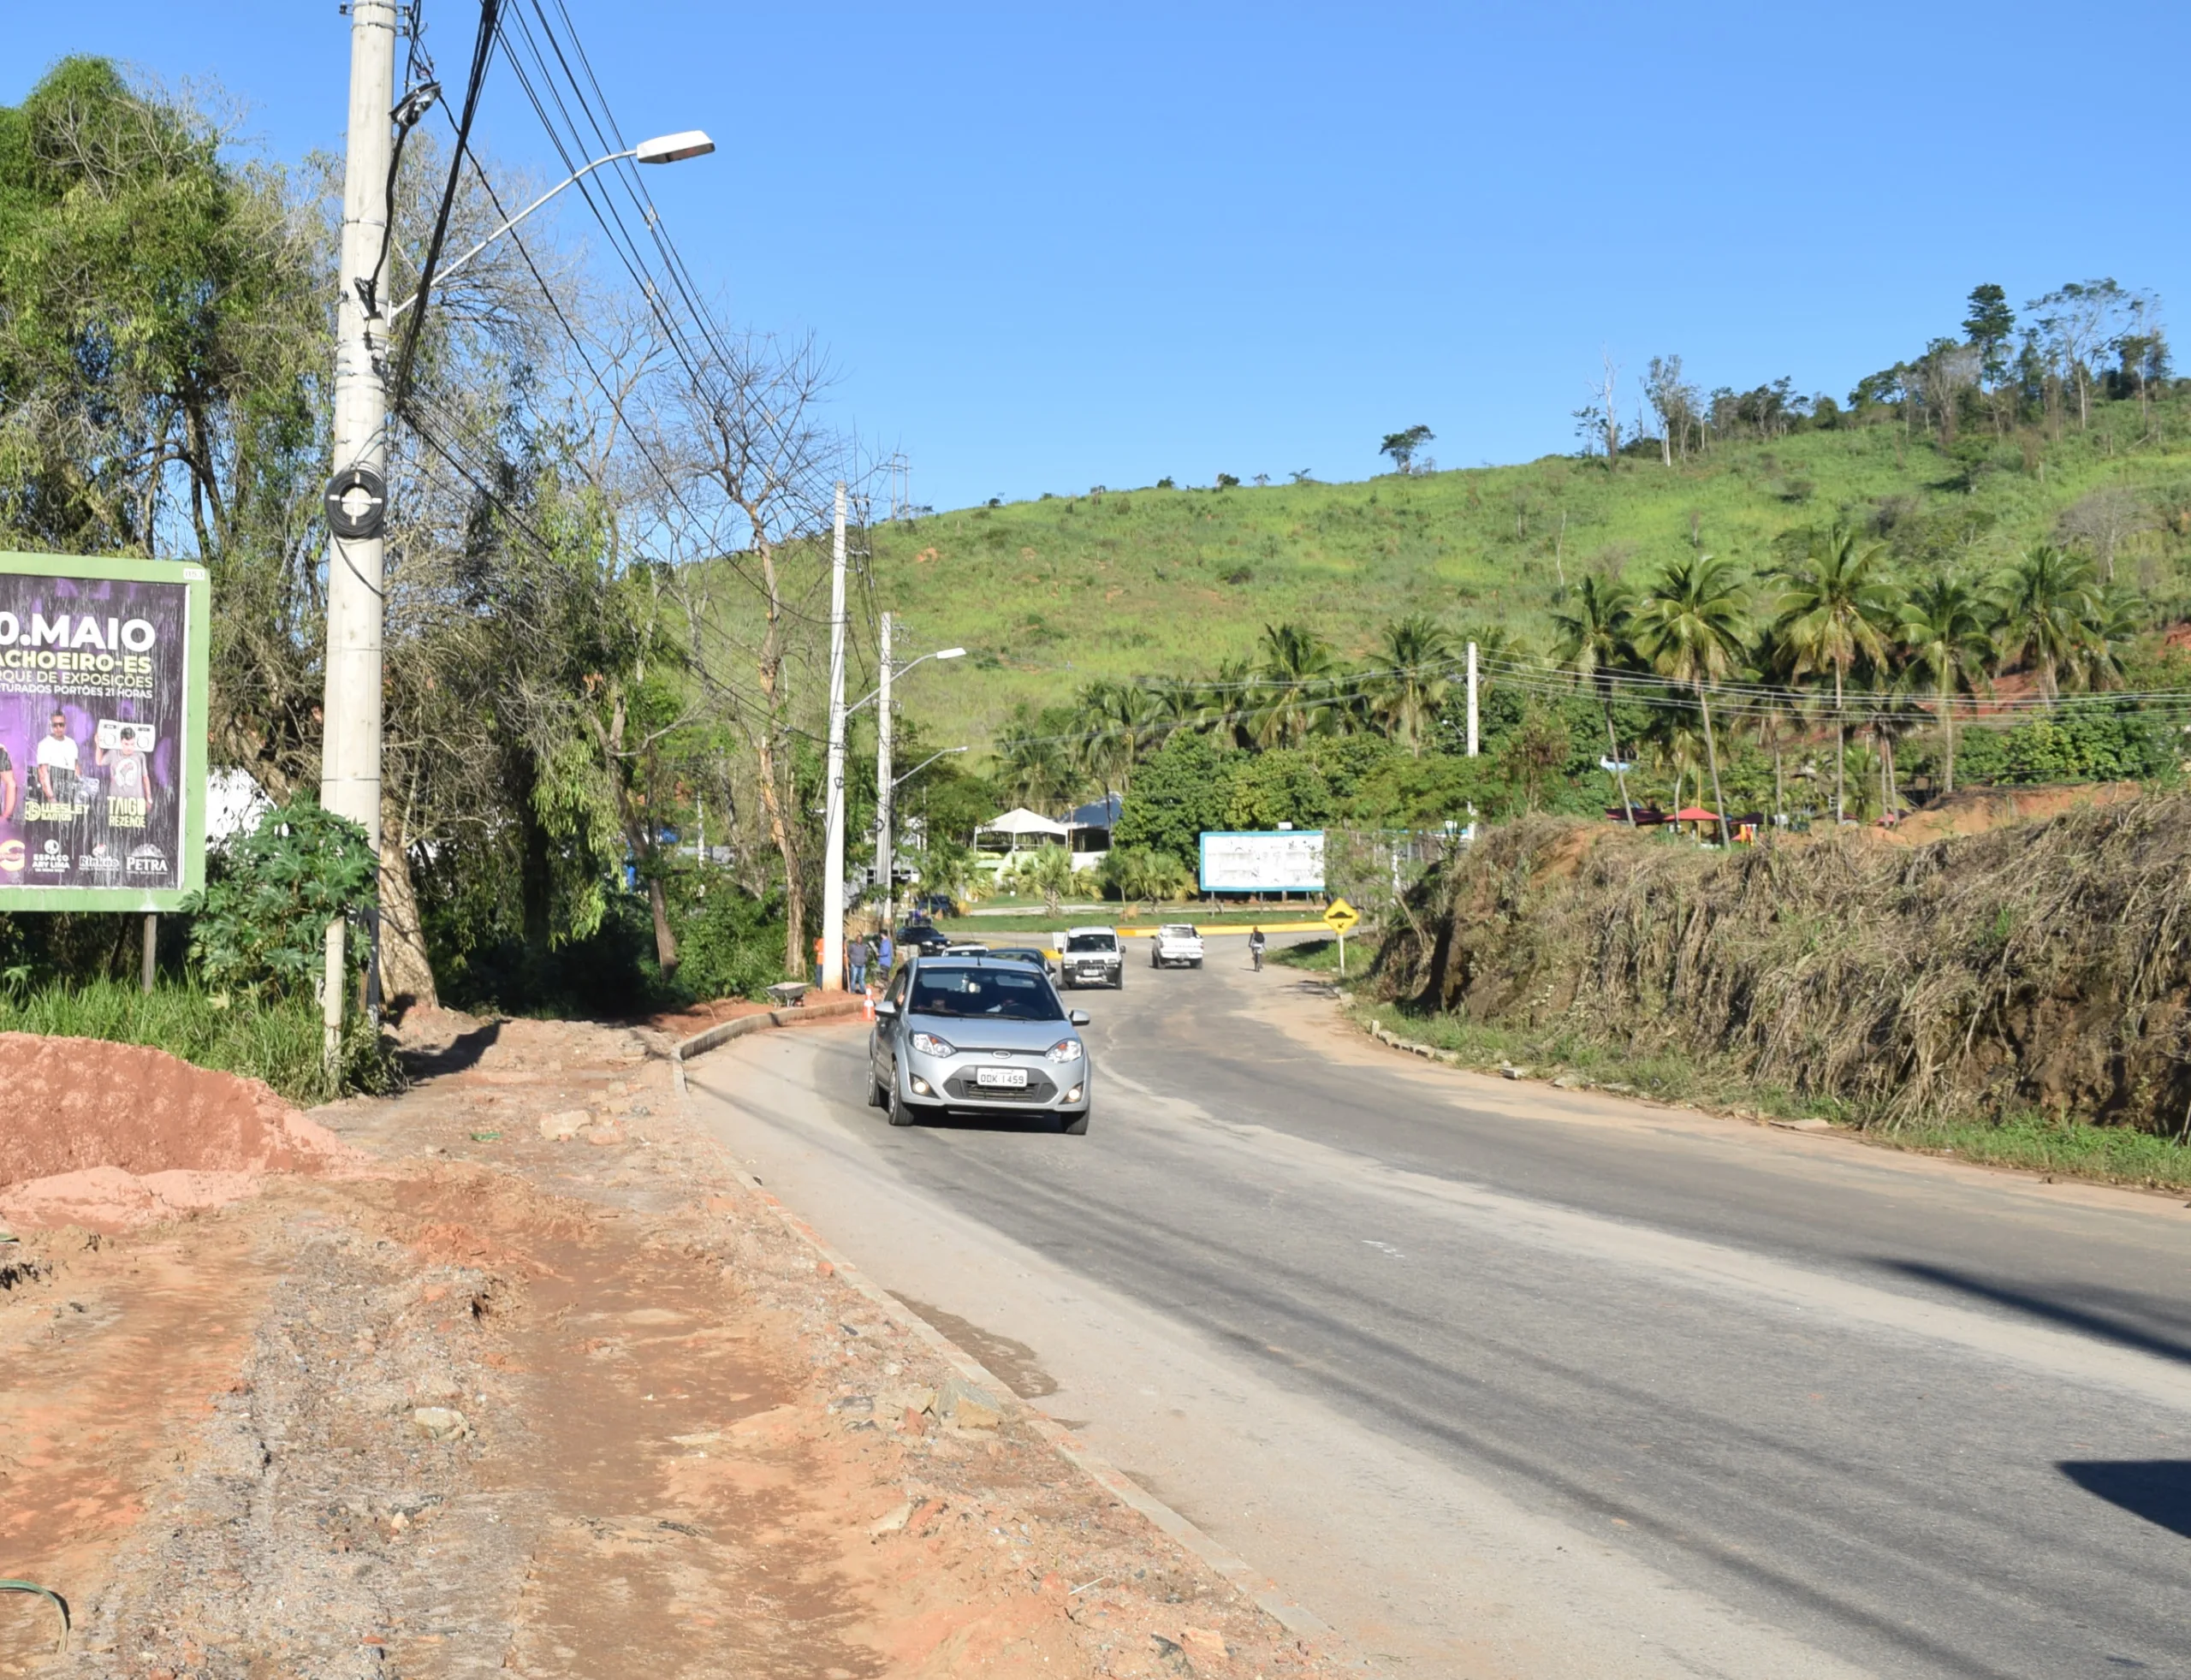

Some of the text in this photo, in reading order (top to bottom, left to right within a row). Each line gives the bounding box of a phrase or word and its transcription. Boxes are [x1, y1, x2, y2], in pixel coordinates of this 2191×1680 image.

[0, 669, 153, 689] QUE DE EXPOSIÇÕES
[0, 683, 153, 699] TURADOS PORTÕES 21 HORAS
[109, 816, 146, 828] REZENDE
[126, 857, 168, 871] PETRA
